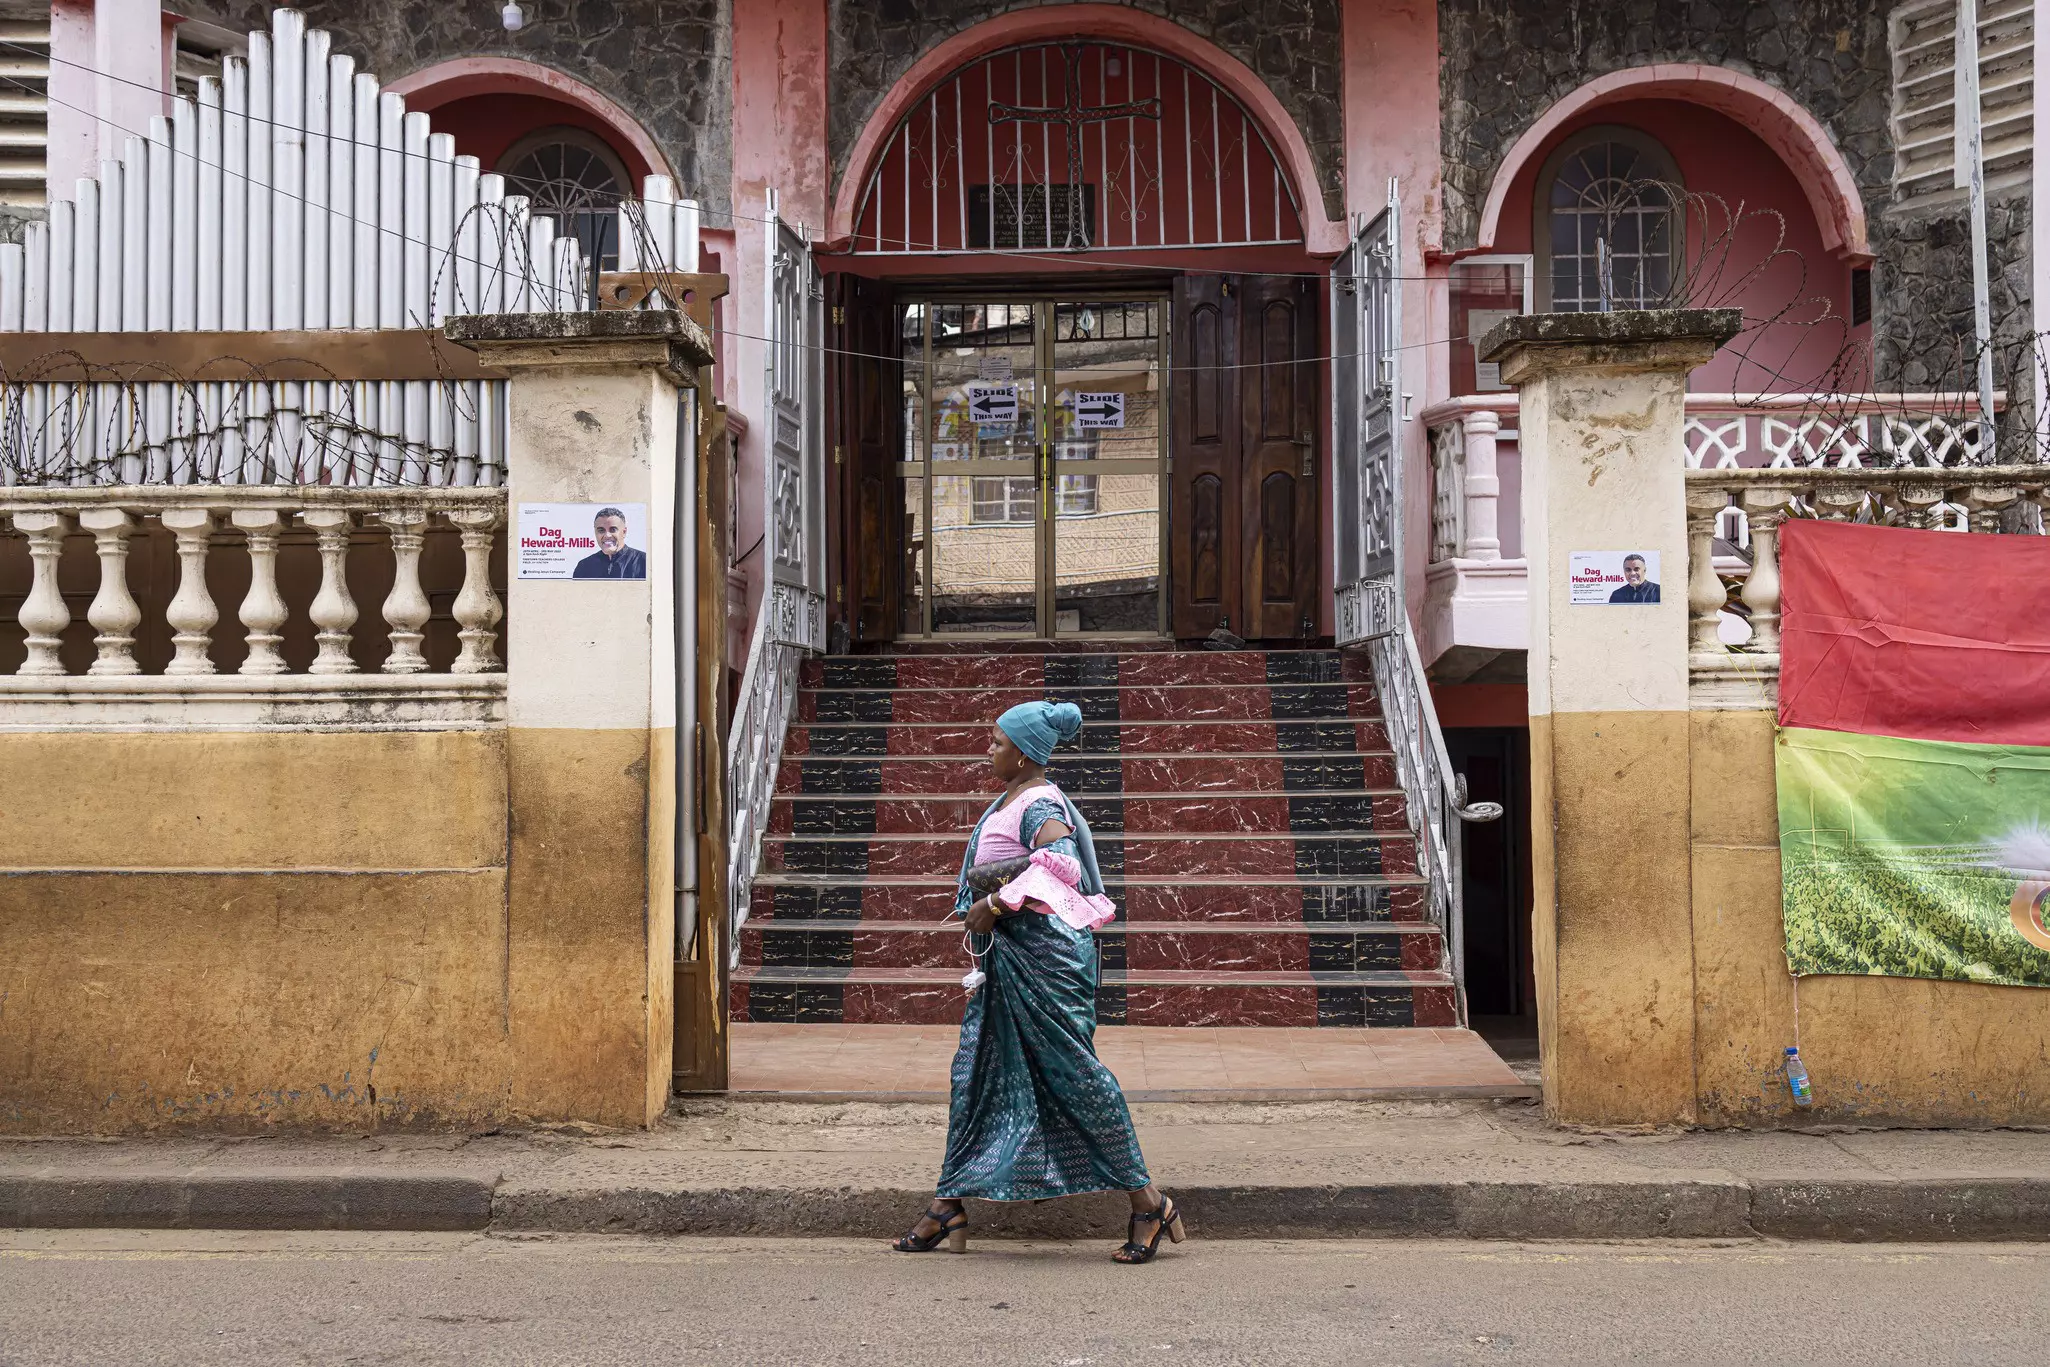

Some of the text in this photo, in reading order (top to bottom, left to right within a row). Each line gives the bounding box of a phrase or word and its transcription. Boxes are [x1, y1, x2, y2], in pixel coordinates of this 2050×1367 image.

[973, 387, 1014, 398] SLIDE
[1079, 394, 1120, 404] SLIDE
[973, 412, 1013, 421] THIS WAY
[1079, 418, 1119, 427] THIS WAY
[539, 526, 562, 539] Dag
[521, 537, 595, 548] Heward-Mills
[1584, 567, 1601, 576] Dag
[1571, 575, 1625, 583] Heward-Mills
